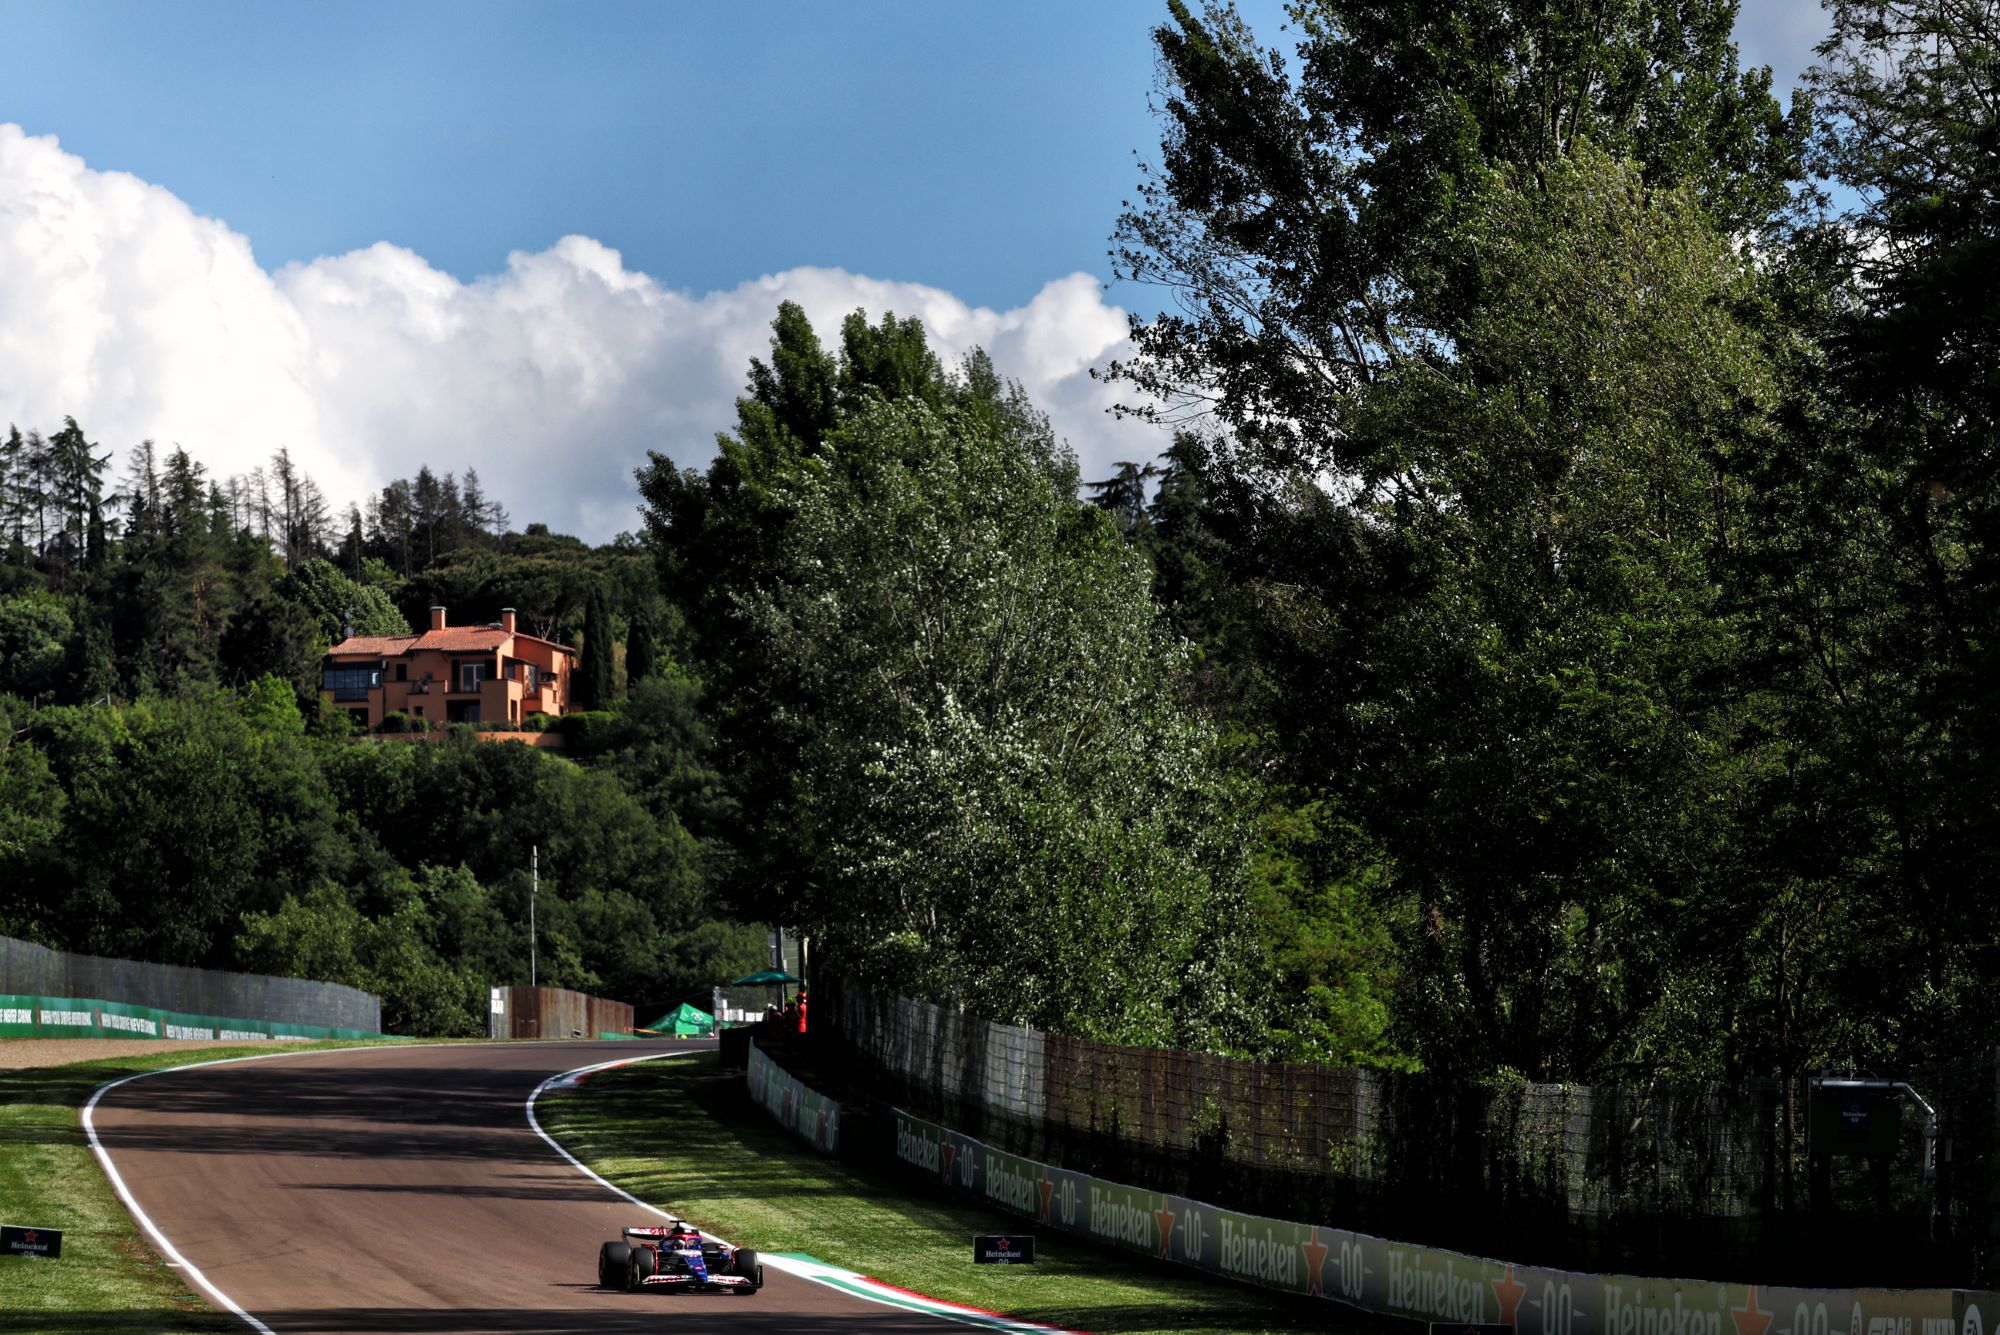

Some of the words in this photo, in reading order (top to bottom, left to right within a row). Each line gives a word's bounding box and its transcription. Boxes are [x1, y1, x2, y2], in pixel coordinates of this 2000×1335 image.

[897, 1117, 940, 1174] Heineken
[986, 1154, 1035, 1213] Heineken
[11, 1241, 48, 1251] Heineken
[1090, 1186, 1152, 1248] Heineken
[1184, 1208, 1202, 1262] 0.0
[985, 1250, 1022, 1258] Heineken
[1220, 1217, 1298, 1286] Heineken
[1341, 1241, 1364, 1300] 0.0
[1388, 1249, 1486, 1324] Heineken
[1543, 1280, 1573, 1335] 00
